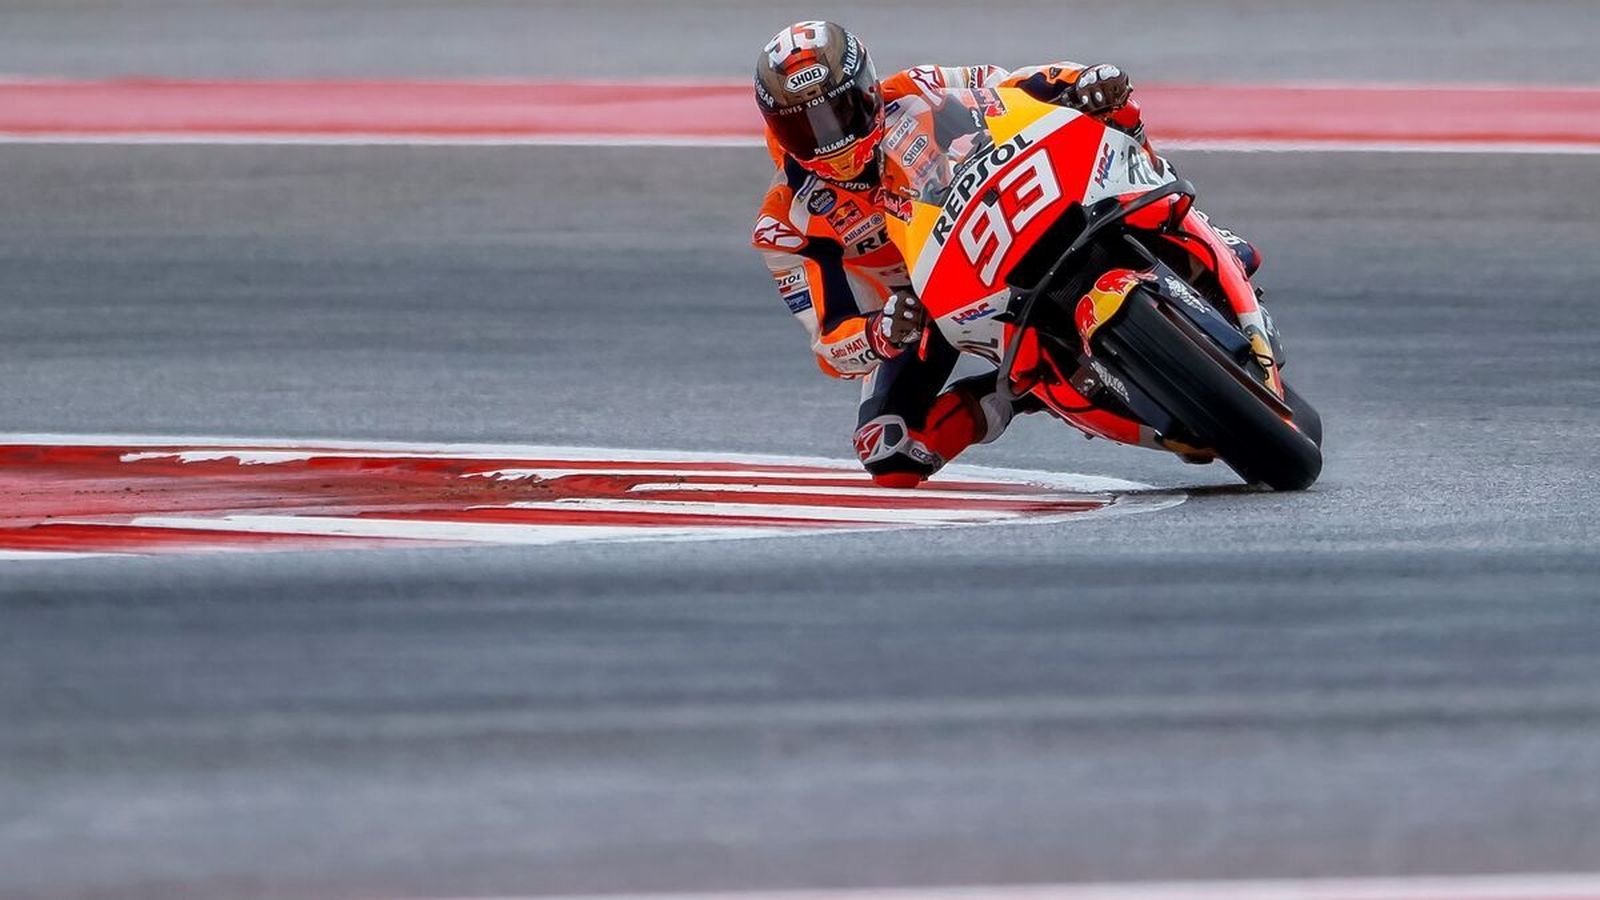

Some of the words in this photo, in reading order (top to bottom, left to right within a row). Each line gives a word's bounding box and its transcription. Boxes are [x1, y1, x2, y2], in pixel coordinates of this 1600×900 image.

[790, 67, 822, 87] SHOEI
[806, 96, 825, 109] YOU
[828, 79, 855, 98] WINGS
[814, 134, 855, 155] PULL&BEAR
[903, 137, 926, 165] SHOEI
[932, 133, 1033, 247] REPSOL
[959, 148, 1061, 287] 93
[844, 222, 871, 244] Allianz
